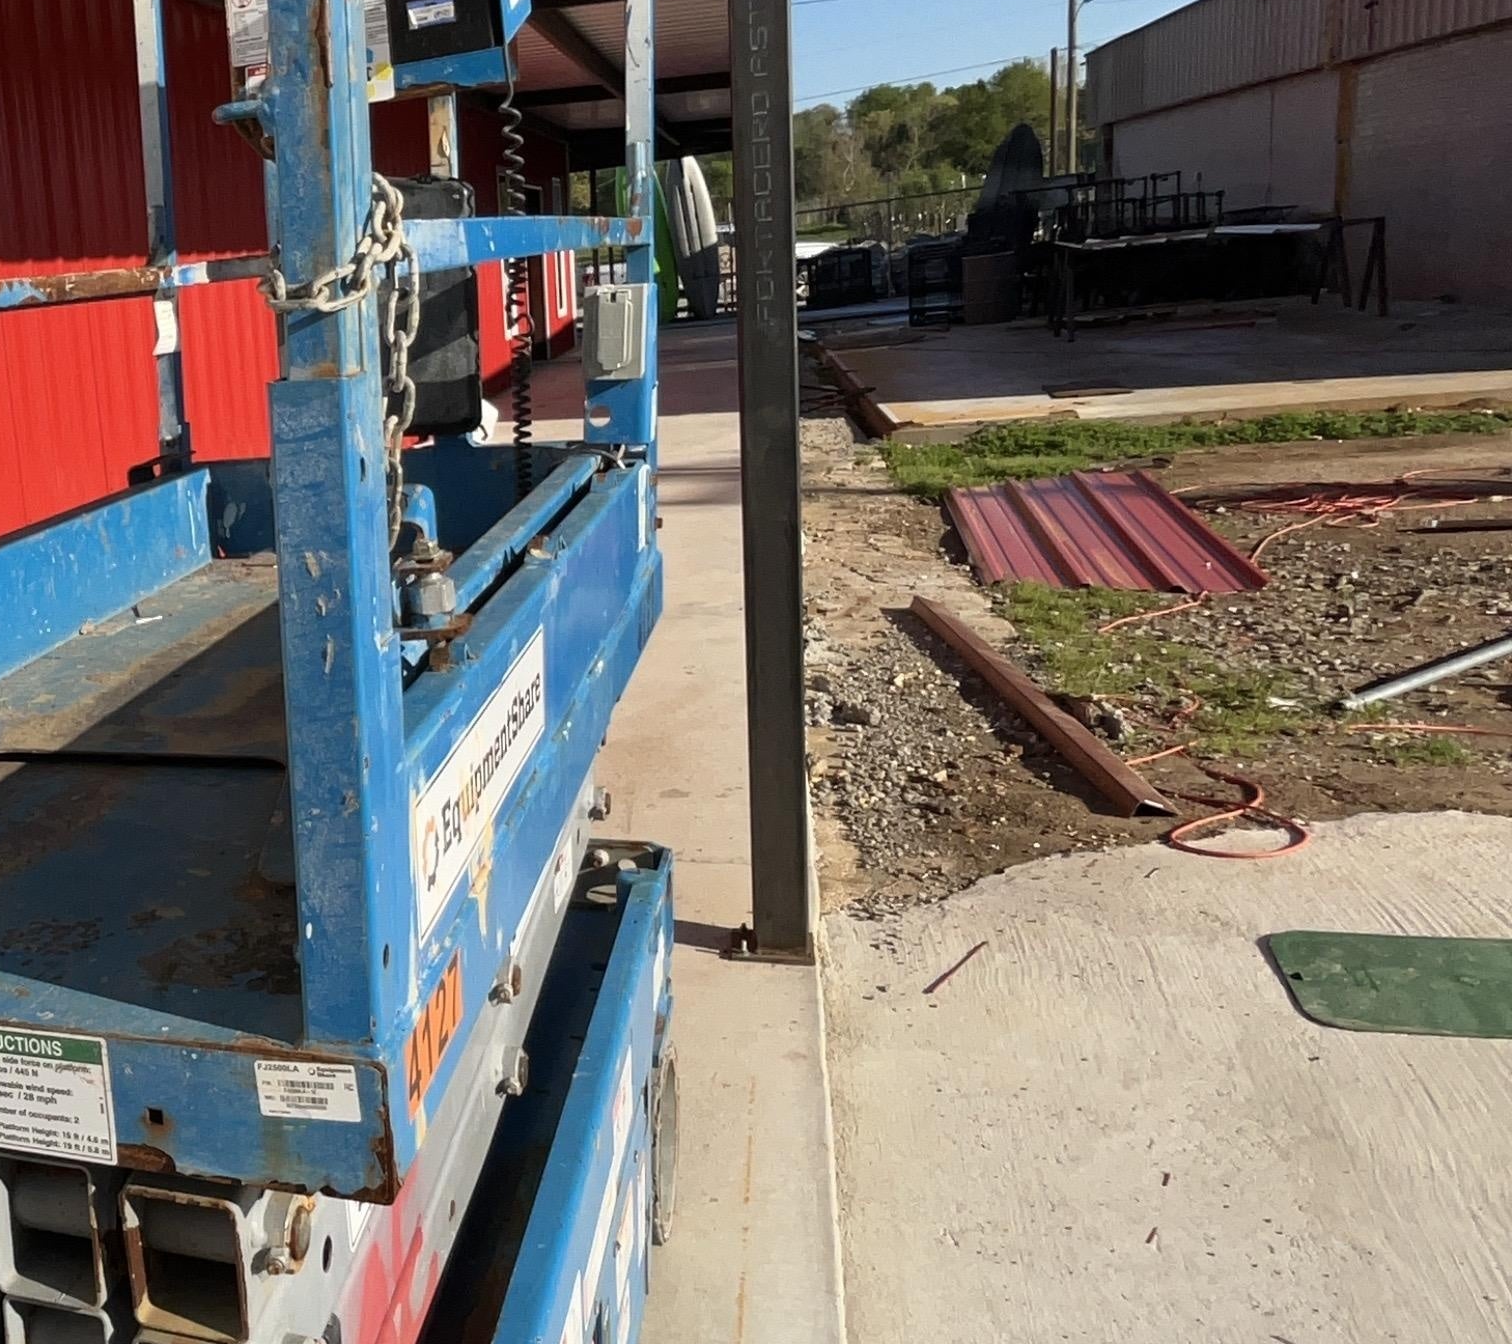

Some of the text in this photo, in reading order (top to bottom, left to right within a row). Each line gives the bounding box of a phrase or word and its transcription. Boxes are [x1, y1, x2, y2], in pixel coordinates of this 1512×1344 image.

[441, 672, 541, 857] EquipmentShare
[409, 951, 458, 1102] 4127
[2, 1056, 19, 1065] side
[21, 1058, 40, 1068] force
[25, 1084, 45, 1092] wind
[23, 1092, 35, 1101] 28
[36, 1095, 58, 1105] mph
[74, 1116, 80, 1124] 2
